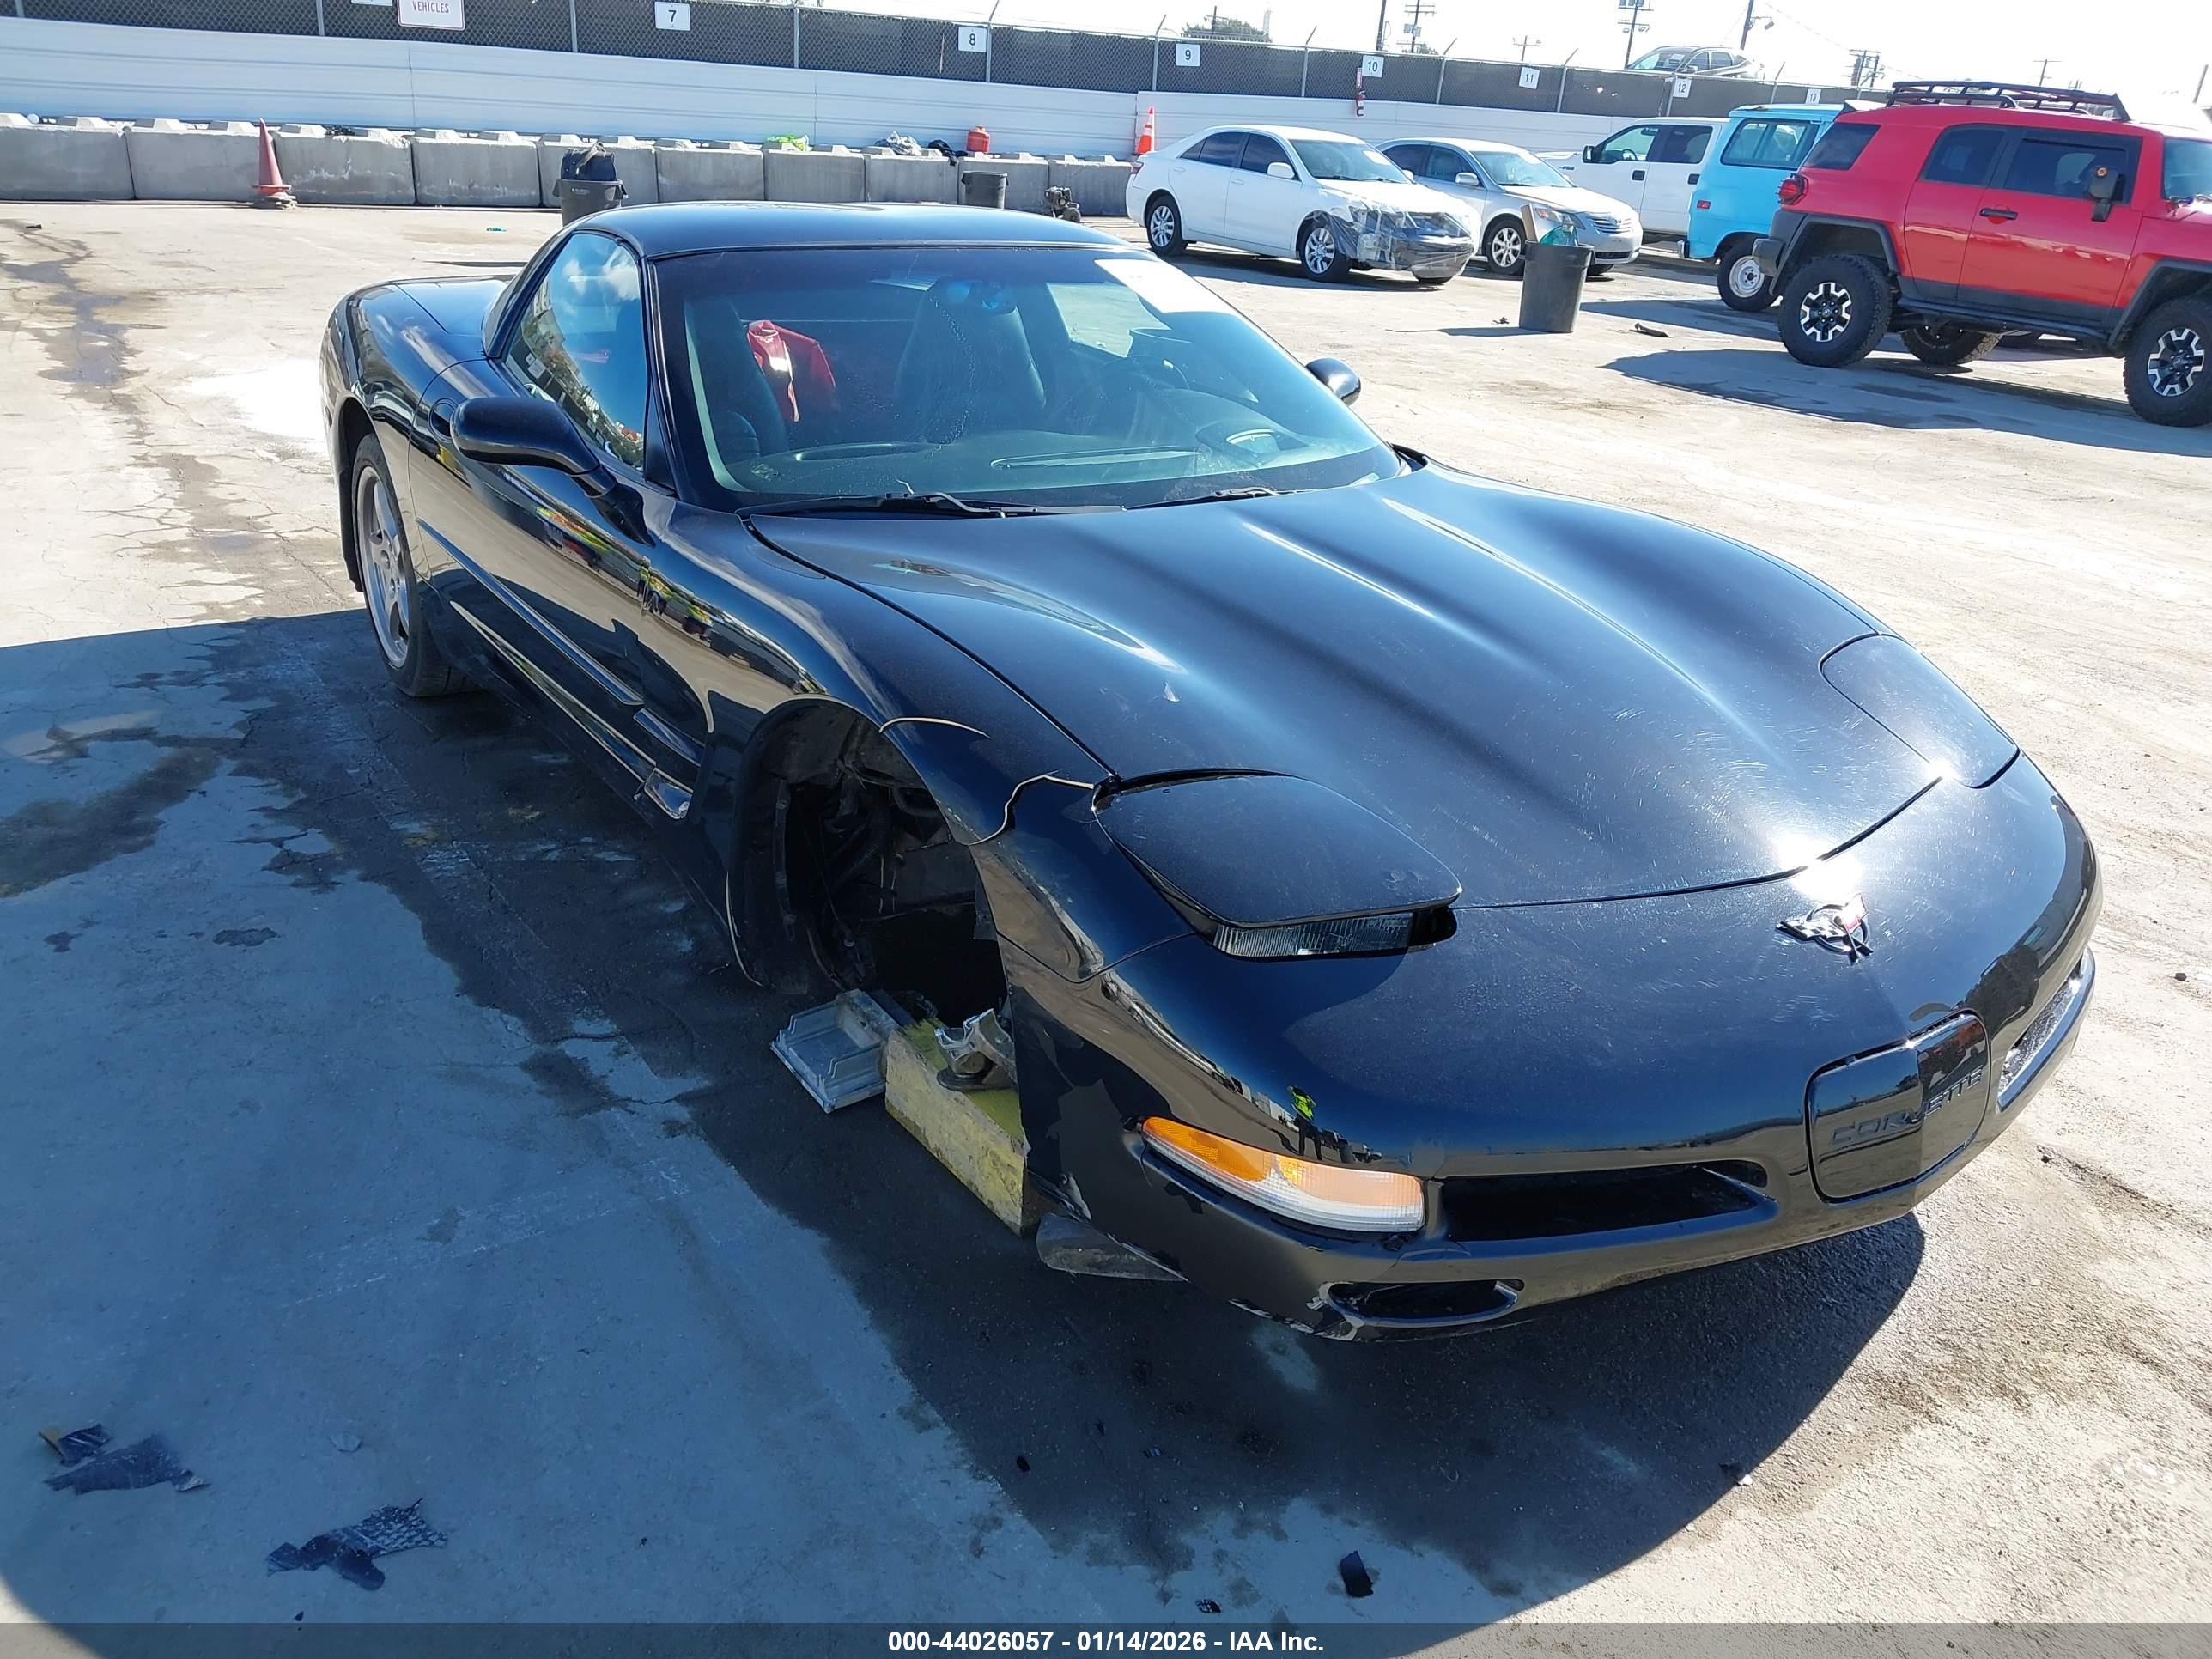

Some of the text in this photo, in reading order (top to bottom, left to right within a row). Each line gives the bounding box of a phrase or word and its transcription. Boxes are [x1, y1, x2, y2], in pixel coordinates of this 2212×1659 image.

[412, 1, 449, 13] VEHICLES
[668, 9, 677, 22] 7
[969, 33, 976, 46] 8
[1185, 49, 1192, 60] 9
[1368, 61, 1378, 72] 10
[1526, 73, 1534, 83] 11
[1678, 83, 1686, 94] 12
[1809, 93, 1817, 102] 13
[1832, 1065, 1983, 1145] CORVETTE
